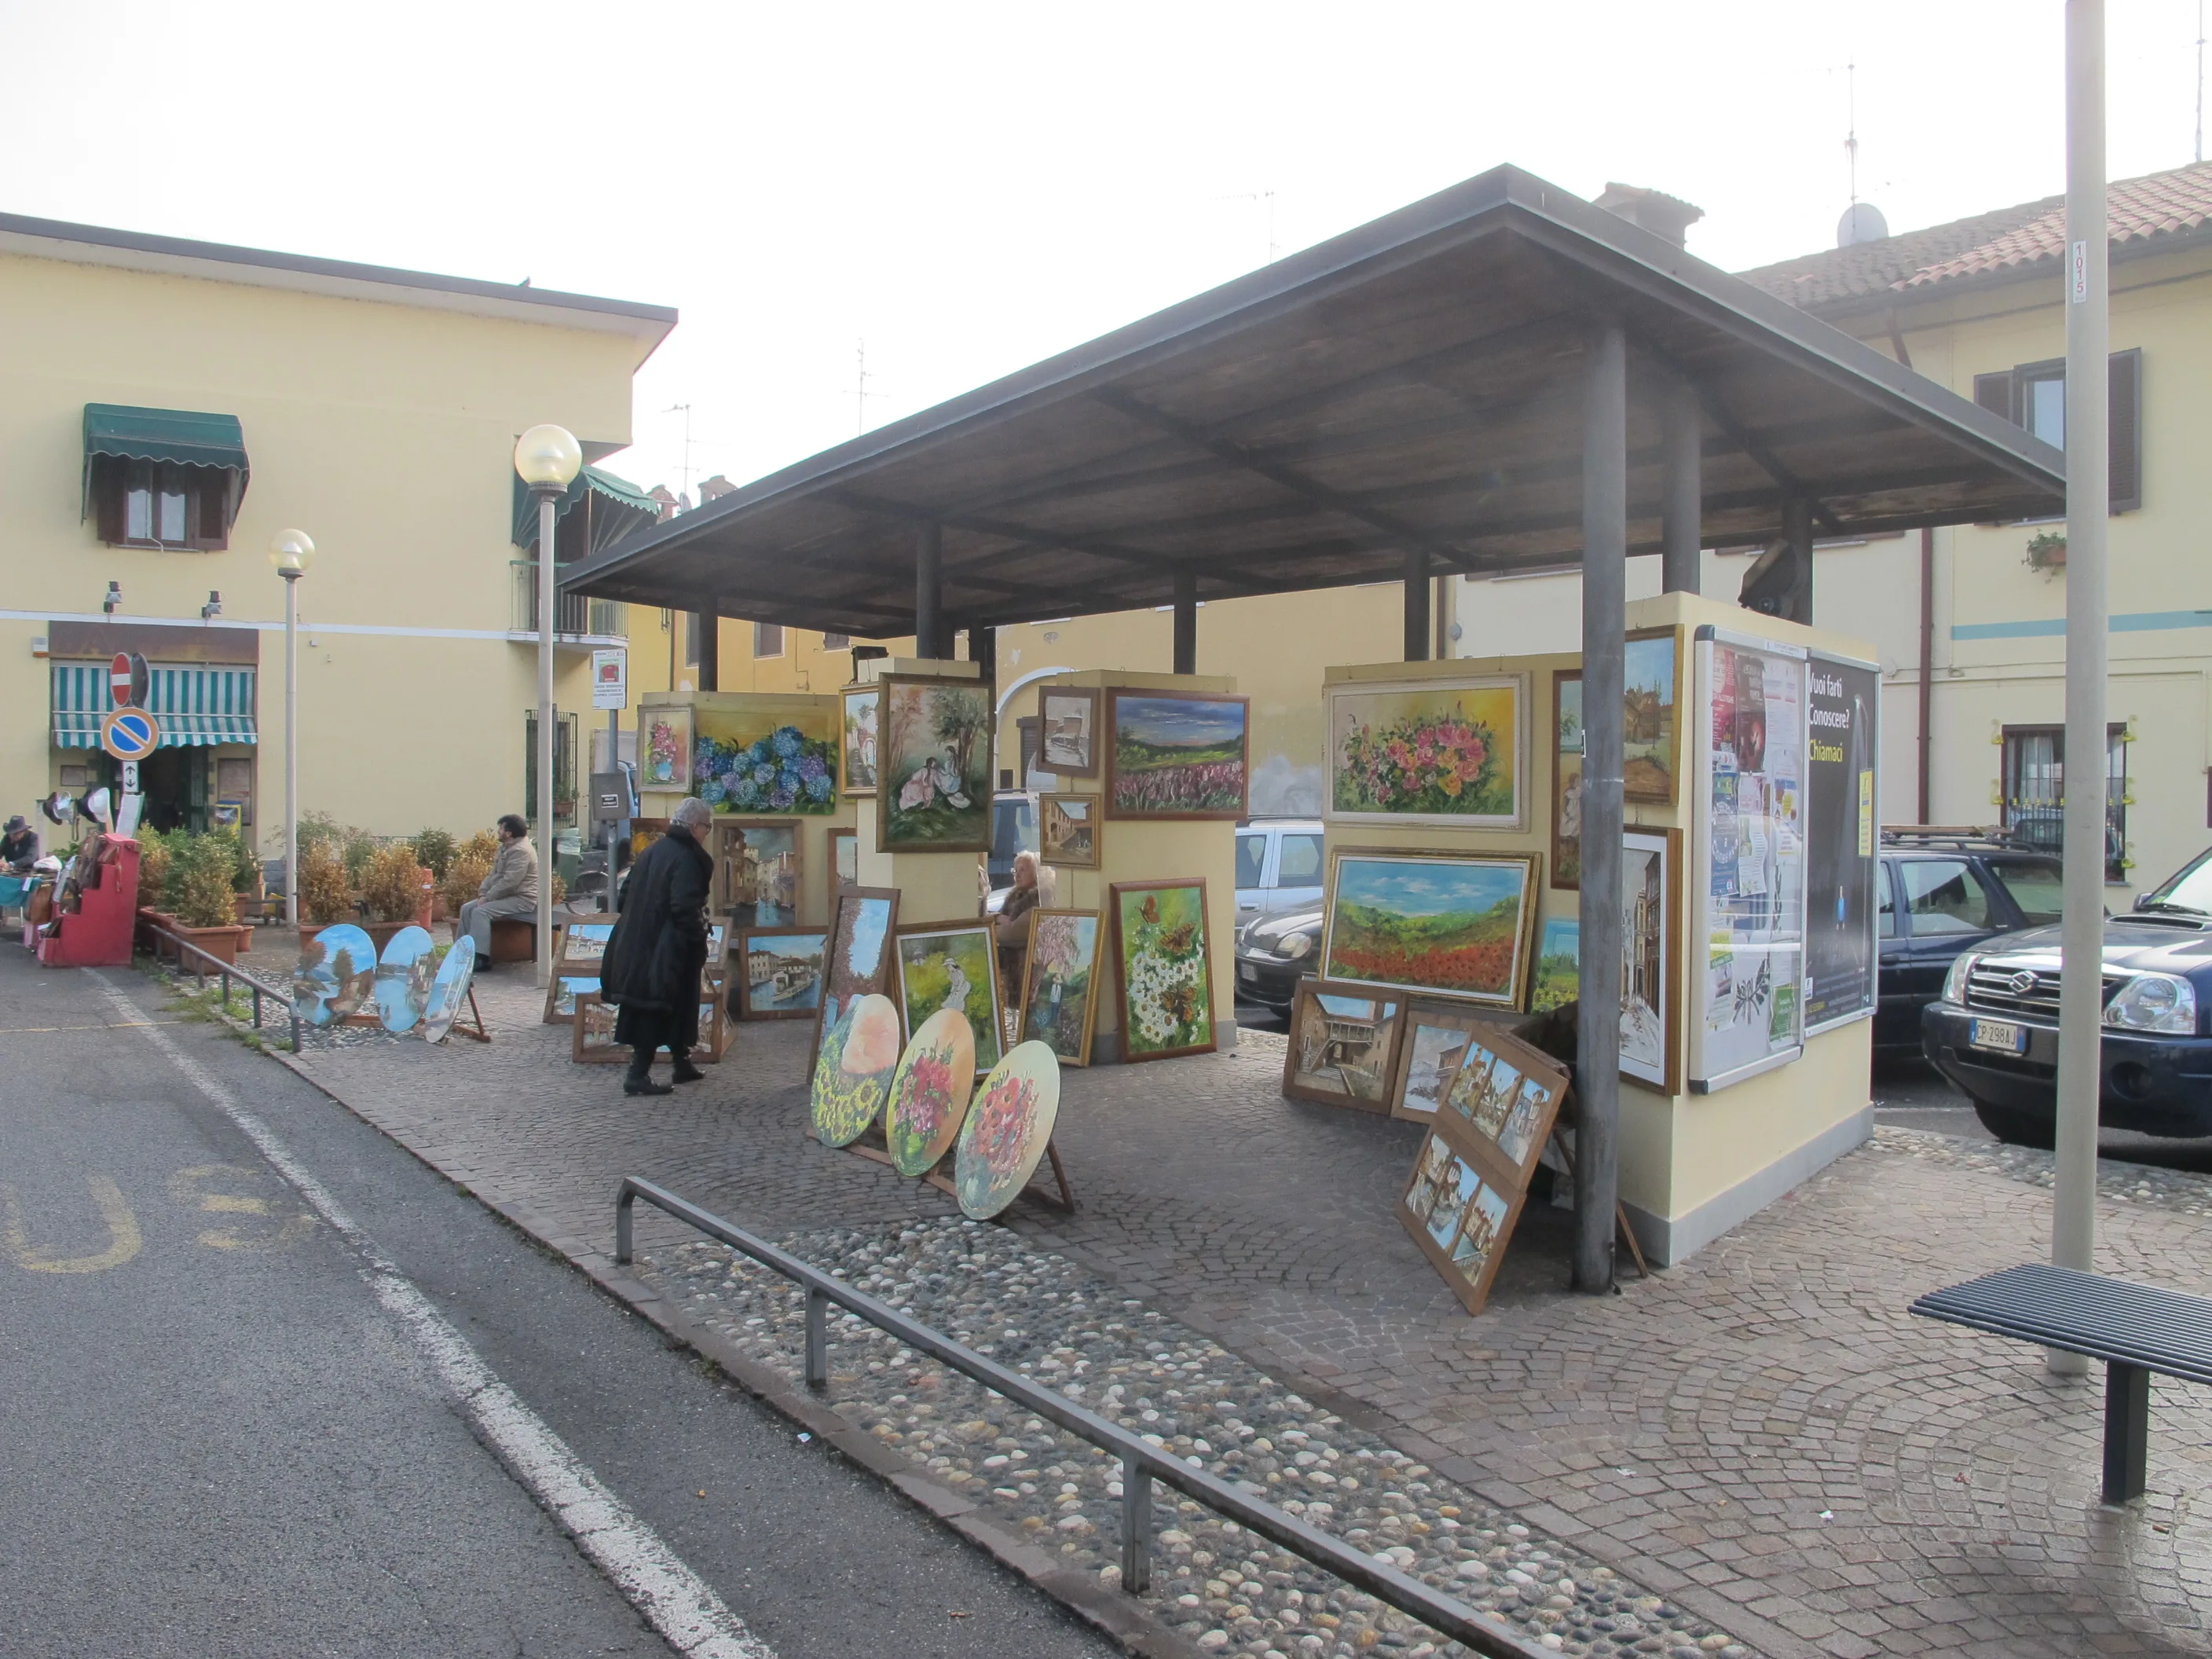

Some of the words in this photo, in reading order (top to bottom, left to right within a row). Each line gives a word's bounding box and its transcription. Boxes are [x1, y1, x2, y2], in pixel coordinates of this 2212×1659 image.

[1809, 672, 1826, 695] Vuoi
[1827, 675, 1842, 698] farti
[1809, 704, 1850, 729] Conoscere?
[1809, 738, 1843, 763] Chiamaci
